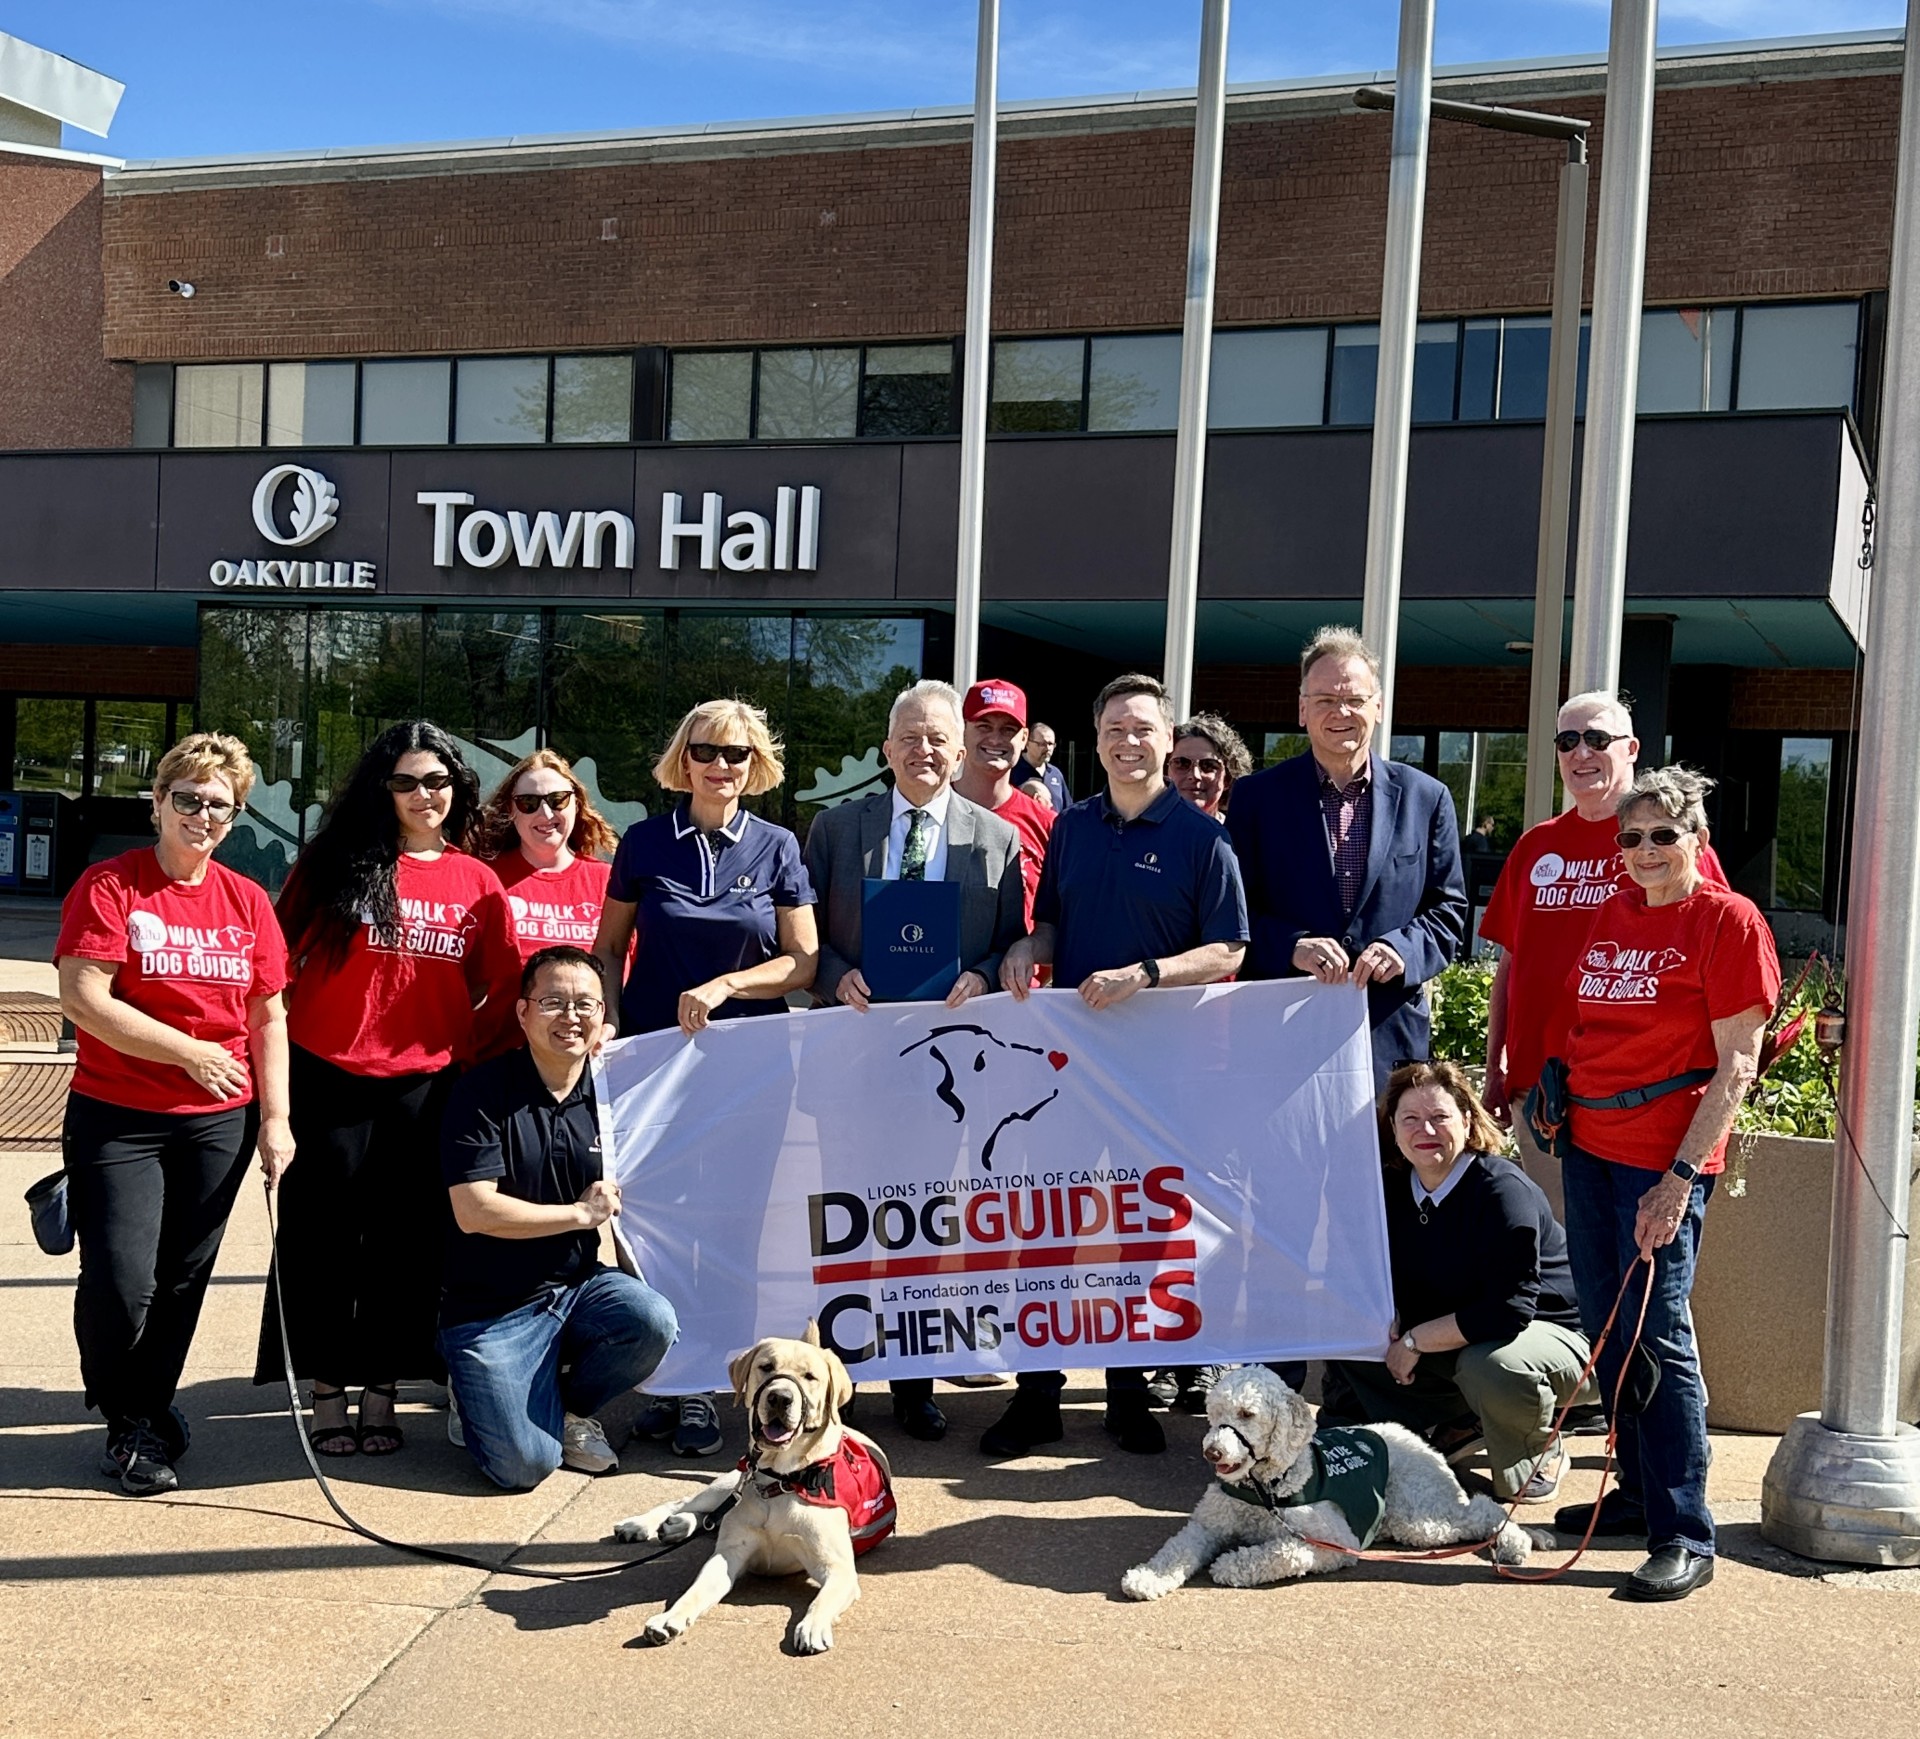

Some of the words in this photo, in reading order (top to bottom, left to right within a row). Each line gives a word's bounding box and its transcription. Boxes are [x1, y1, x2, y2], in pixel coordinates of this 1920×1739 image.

[417, 491, 635, 569] Town
[659, 485, 821, 572] Hall
[209, 559, 377, 590] OAKVILLE
[1565, 859, 1608, 879] WALK
[1535, 886, 1568, 906] DOG
[528, 901, 575, 920] WALK
[167, 924, 222, 948] WALK
[405, 927, 466, 958] GUIDES
[542, 923, 599, 940] GUIDES
[889, 945, 935, 954] OAKVILLE
[1613, 949, 1657, 971] WALK
[141, 952, 183, 975] DOG
[186, 954, 251, 981] GUIDES
[1578, 974, 1610, 997] DOG
[866, 1182, 917, 1201] LIONS
[924, 1174, 1036, 1196] FOUNDATION
[1042, 1171, 1065, 1187] OF
[1069, 1167, 1142, 1185] CANADA
[880, 1287, 899, 1303] La
[903, 1282, 980, 1301] Fondation
[983, 1279, 1010, 1295] des
[1015, 1277, 1056, 1293] Lions
[1060, 1274, 1080, 1290] du
[1084, 1271, 1142, 1288] Canada
